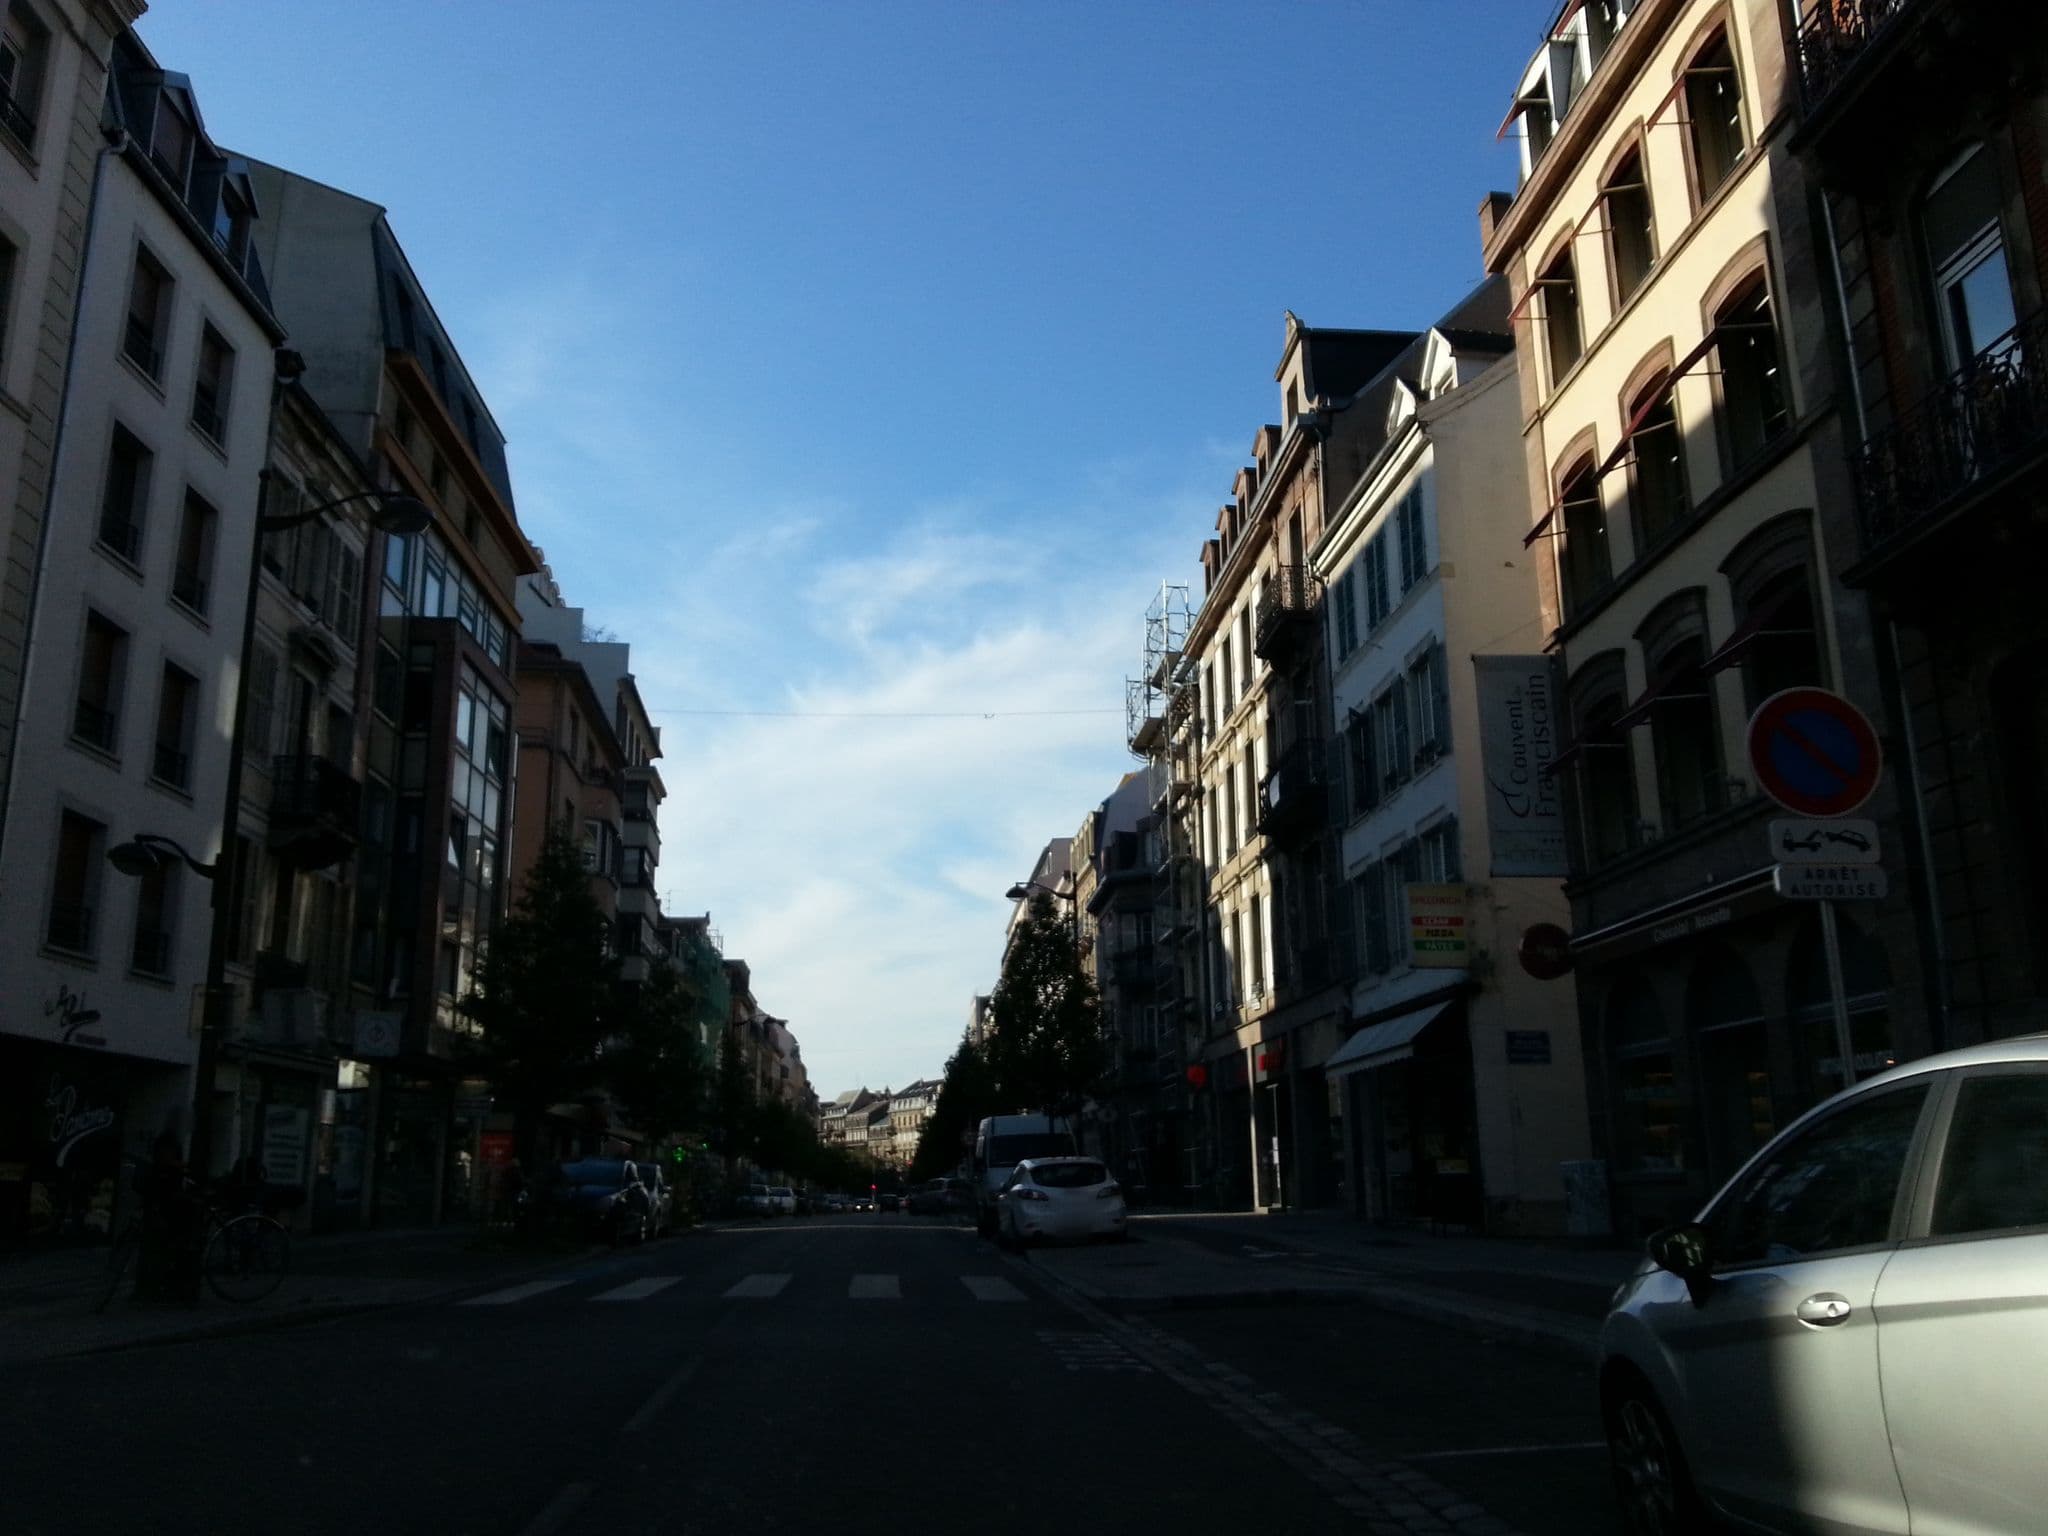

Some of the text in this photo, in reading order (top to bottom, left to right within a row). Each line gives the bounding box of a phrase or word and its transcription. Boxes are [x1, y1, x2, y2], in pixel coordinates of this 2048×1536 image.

[1507, 699, 1528, 785] Couvent
[1806, 866, 1858, 880] ARRÊT
[1425, 928, 1455, 938] PIZZA
